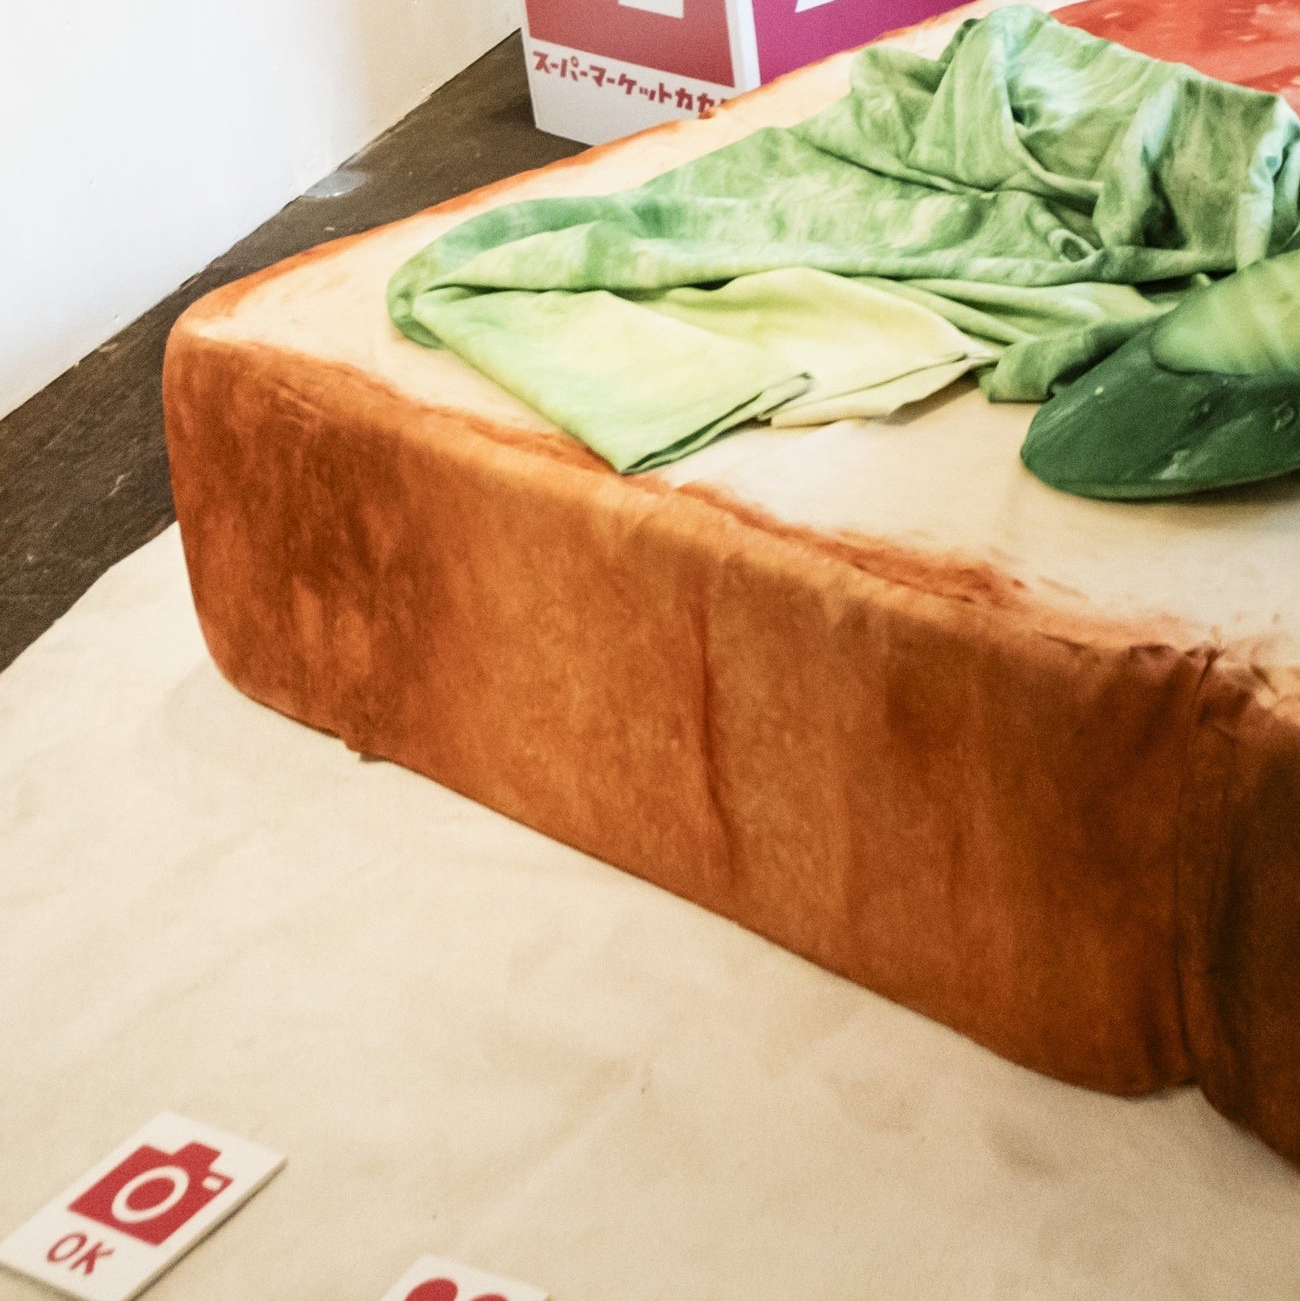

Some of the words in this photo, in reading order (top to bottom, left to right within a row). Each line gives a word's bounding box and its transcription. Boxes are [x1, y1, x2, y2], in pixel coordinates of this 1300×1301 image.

[532, 50, 731, 114] スーパーマーケットカカ
[46, 1232, 116, 1276] OK
